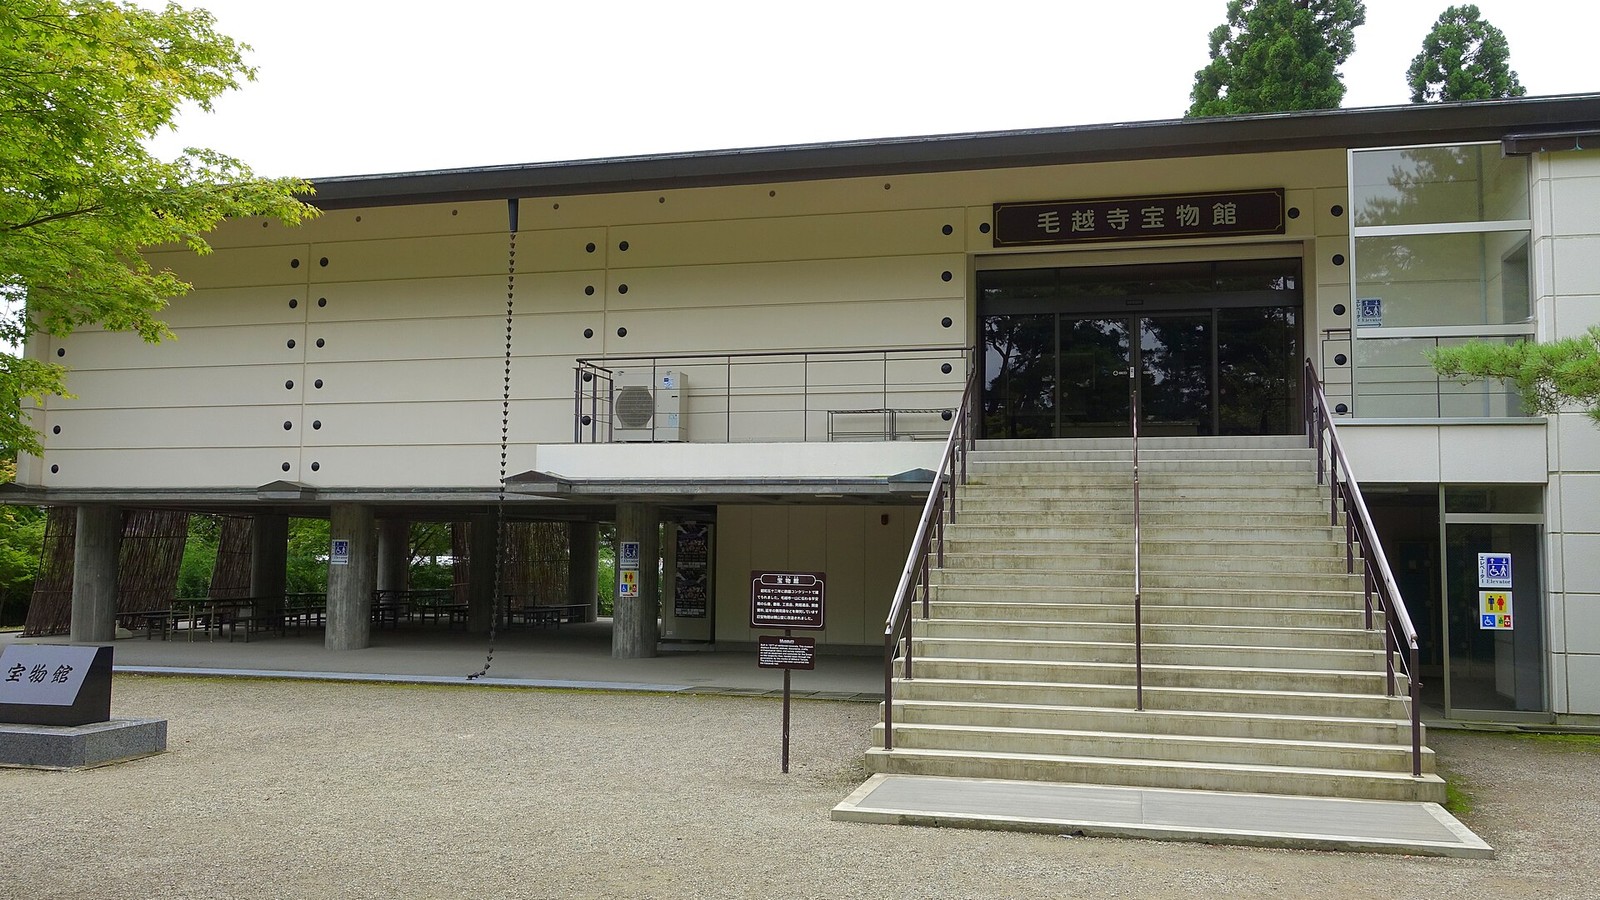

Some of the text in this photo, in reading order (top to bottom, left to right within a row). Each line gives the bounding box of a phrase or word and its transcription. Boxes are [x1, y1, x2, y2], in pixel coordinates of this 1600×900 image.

[1037, 202, 1237, 233] 毛越寺宝物館
[5, 662, 74, 684] 宝物館
